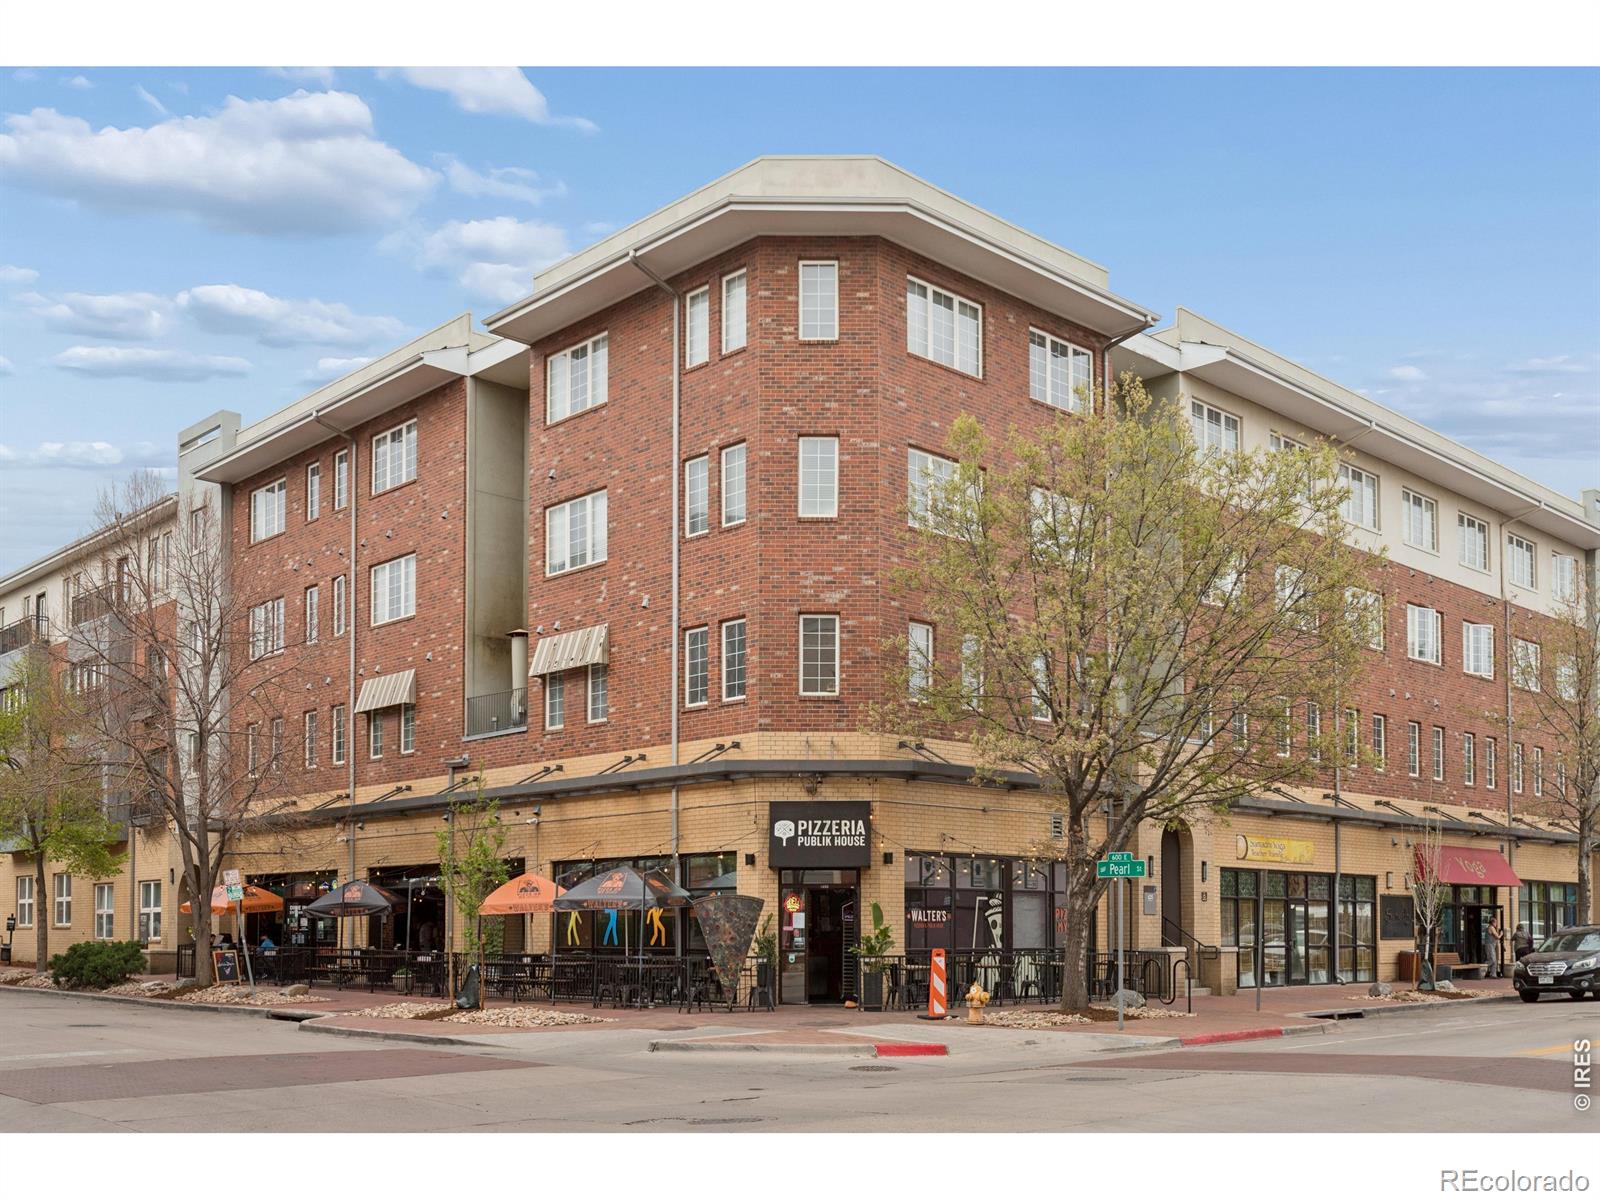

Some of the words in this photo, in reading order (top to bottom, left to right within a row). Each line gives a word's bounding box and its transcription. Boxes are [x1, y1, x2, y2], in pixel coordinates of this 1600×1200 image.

[798, 820, 866, 835] PIZZERIA
[798, 836, 832, 846] PUBLIK
[834, 836, 866, 846] HOUSE
[1109, 863, 1131, 875] Pearl
[1453, 856, 1487, 879] Yoga
[911, 910, 947, 922] WALTER'S
